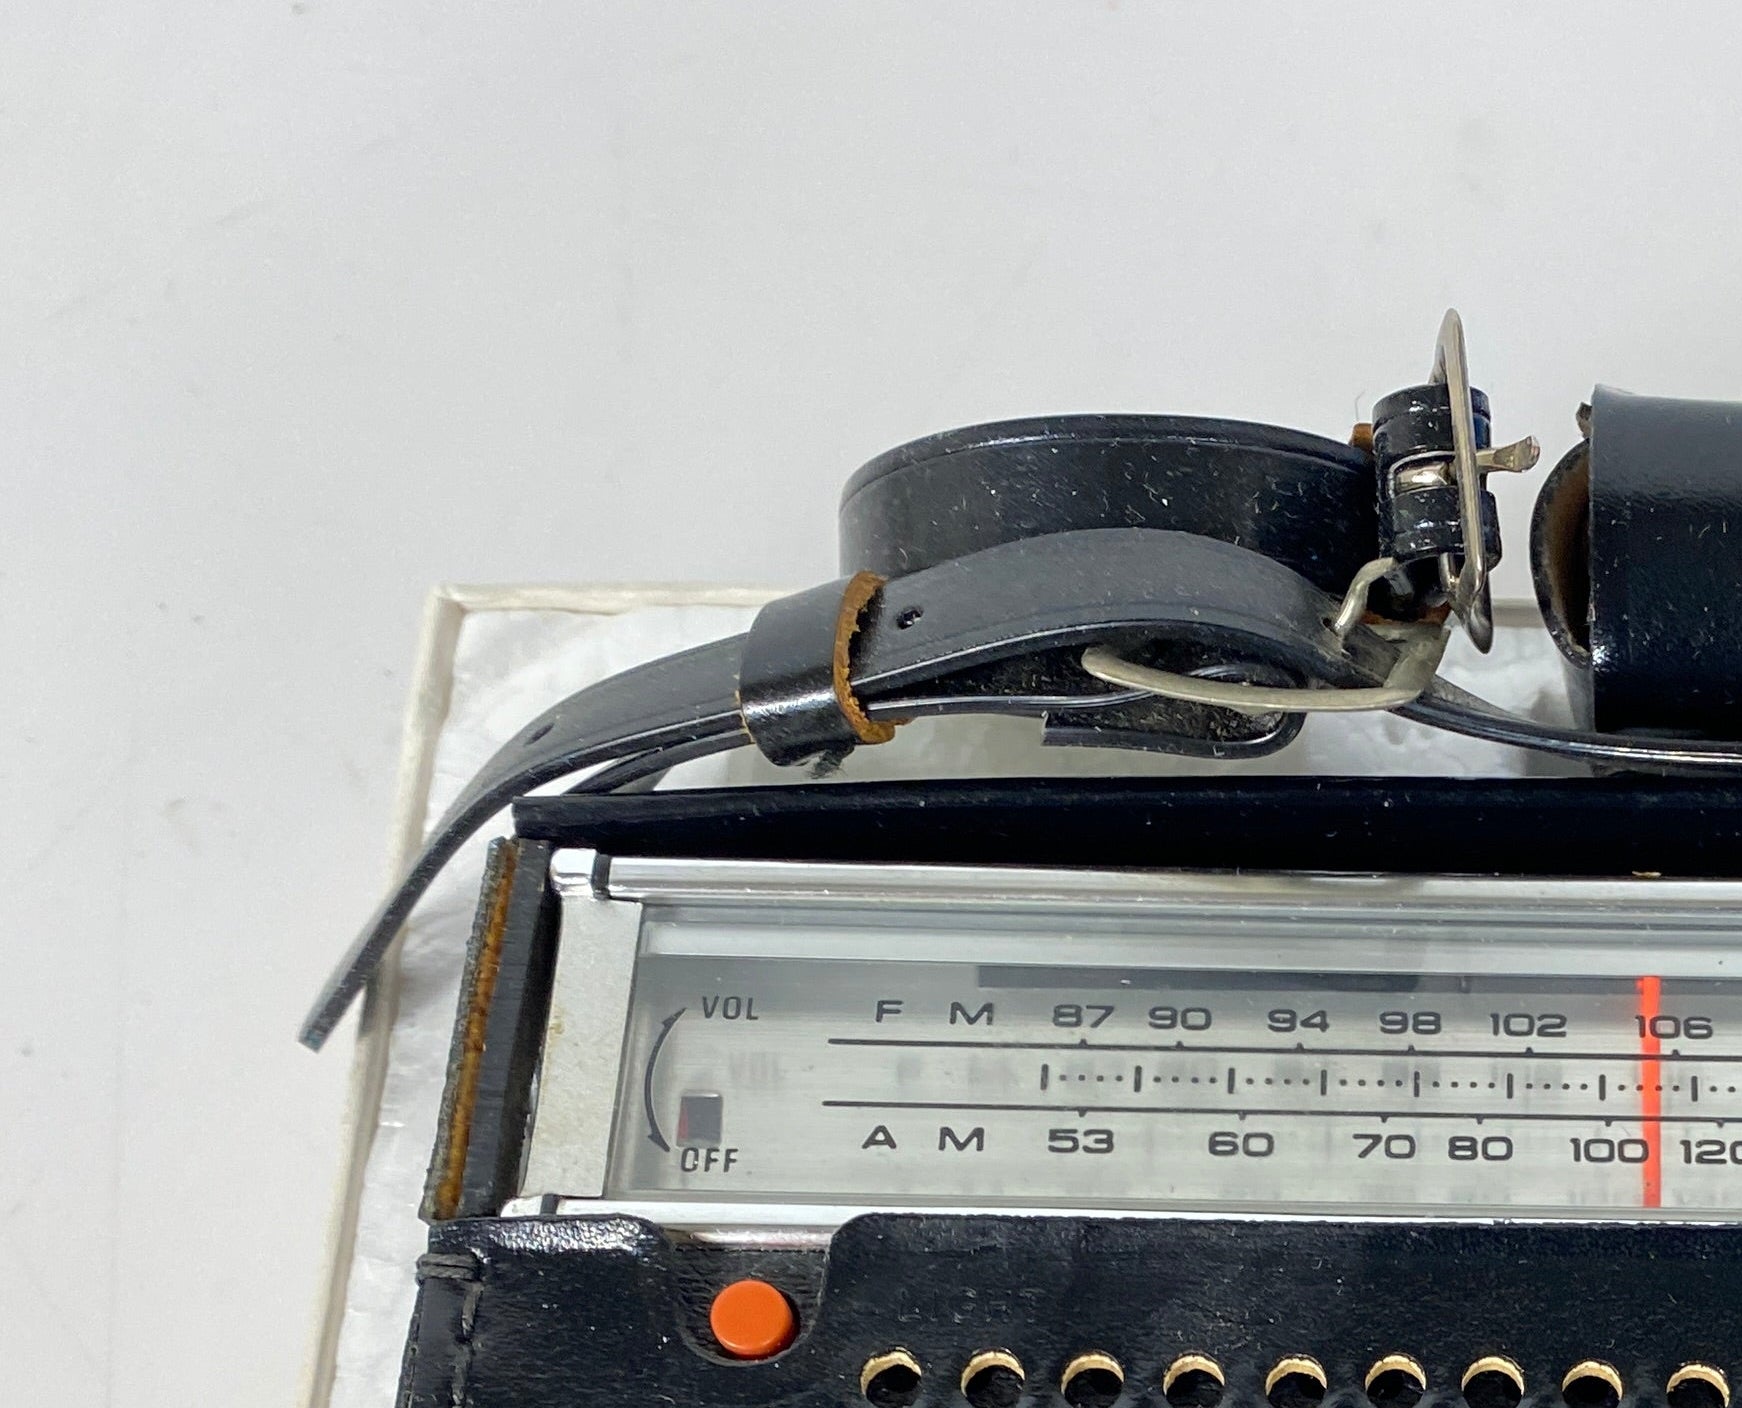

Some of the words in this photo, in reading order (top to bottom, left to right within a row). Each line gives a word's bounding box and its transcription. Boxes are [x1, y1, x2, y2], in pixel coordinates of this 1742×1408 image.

[702, 996, 759, 1021] VOL
[1053, 1004, 1115, 1029] 87
[1148, 1007, 1212, 1031] 90
[1267, 1008, 1330, 1033] 94
[1379, 1011, 1442, 1034] 98
[1491, 1013, 1567, 1037] 102
[1635, 1015, 1713, 1039] 106
[681, 1148, 739, 1172] OFF
[1048, 1130, 1114, 1154] 53
[1209, 1132, 1275, 1157] 60
[1352, 1134, 1416, 1159] 70
[1448, 1136, 1513, 1160] 80
[1570, 1137, 1649, 1163] 100
